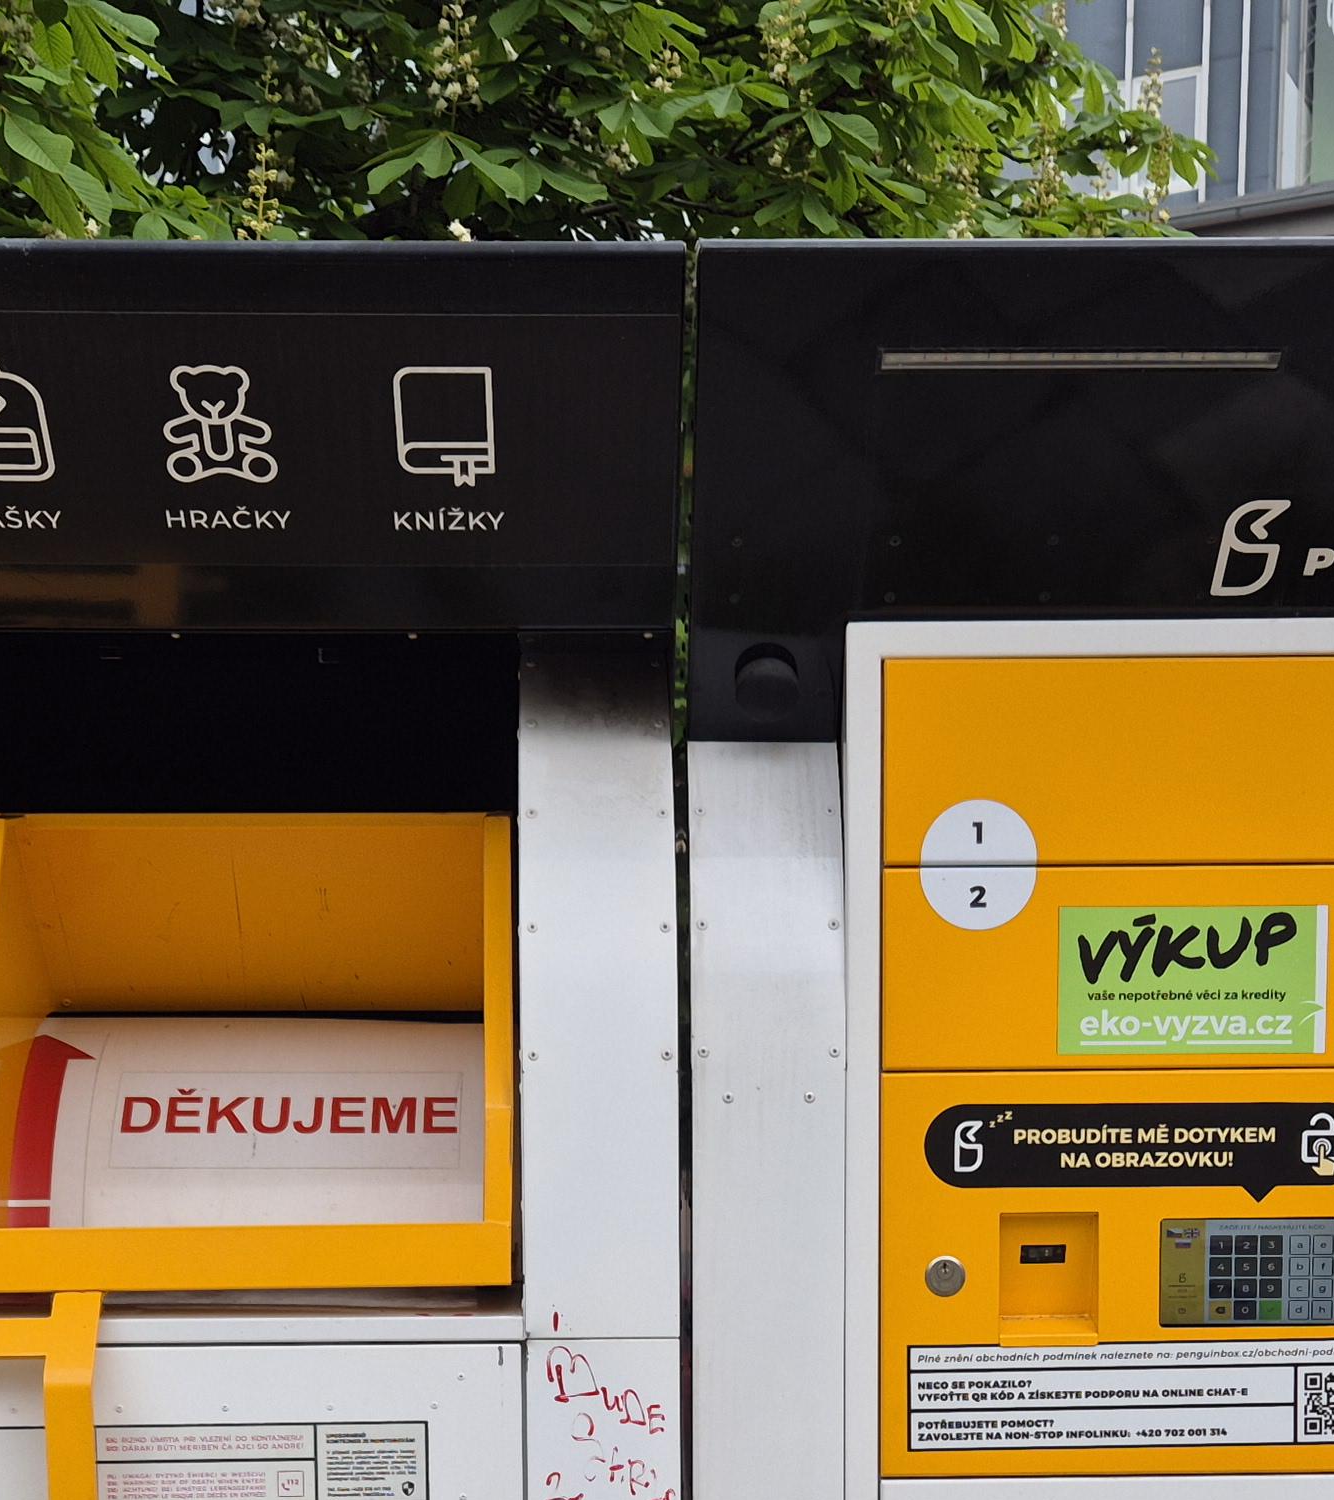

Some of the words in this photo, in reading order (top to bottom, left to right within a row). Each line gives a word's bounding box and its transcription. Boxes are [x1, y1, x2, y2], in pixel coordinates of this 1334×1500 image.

[165, 505, 292, 531] HRAČKY
[393, 506, 506, 532] KNÍŽKY
[971, 821, 984, 844] 1
[969, 885, 987, 908] 2
[1077, 911, 1297, 985] VÝKUP
[1087, 989, 1116, 1001] vaše
[1119, 988, 1193, 1003] nepotřebné
[1196, 989, 1221, 1000] věci
[1224, 991, 1239, 1001] za
[1242, 988, 1287, 1002] kredity
[1079, 1008, 1293, 1041] eko-vyzva.cz
[119, 1086, 460, 1136] DĚKUJEME
[1013, 1123, 1133, 1145] PROBUDÍTE
[1137, 1123, 1169, 1144] MĚ
[1174, 1126, 1276, 1144] DOTYKEM
[1060, 1151, 1092, 1168] NA
[1094, 1151, 1234, 1168] OBRAZOVKU!
[917, 1354, 941, 1364] Plné
[975, 1351, 1040, 1362] obchodních
[1042, 1351, 1097, 1362] podmínek
[1100, 1350, 1154, 1360] naleznete
[951, 1380, 966, 1390] SE
[967, 1379, 1033, 1390] POKAZILO?
[971, 1391, 988, 1402] QR
[990, 1390, 1015, 1401] KÓD
[1017, 1391, 1027, 1401] A
[1028, 1388, 1083, 1400] ZÍSKEJTE
[1084, 1389, 1140, 1399] PODPORU
[1142, 1389, 1159, 1398] NA
[1161, 1388, 1204, 1398] ONLINE
[1206, 1387, 1249, 1397] CHAT-E
[917, 1418, 998, 1430] POTŘEBUJETE
[1000, 1418, 1055, 1429] POMOCT?
[917, 1431, 983, 1442] ZAVOLEJTE
[985, 1431, 1002, 1441] NA
[1004, 1430, 1064, 1440] NON-STOP
[1066, 1429, 1131, 1439] INFOLINKU:
[1135, 1428, 1162, 1438] +420
[1164, 1428, 1186, 1437] 702
[1187, 1428, 1207, 1437] 001
[1209, 1427, 1228, 1436] 314
